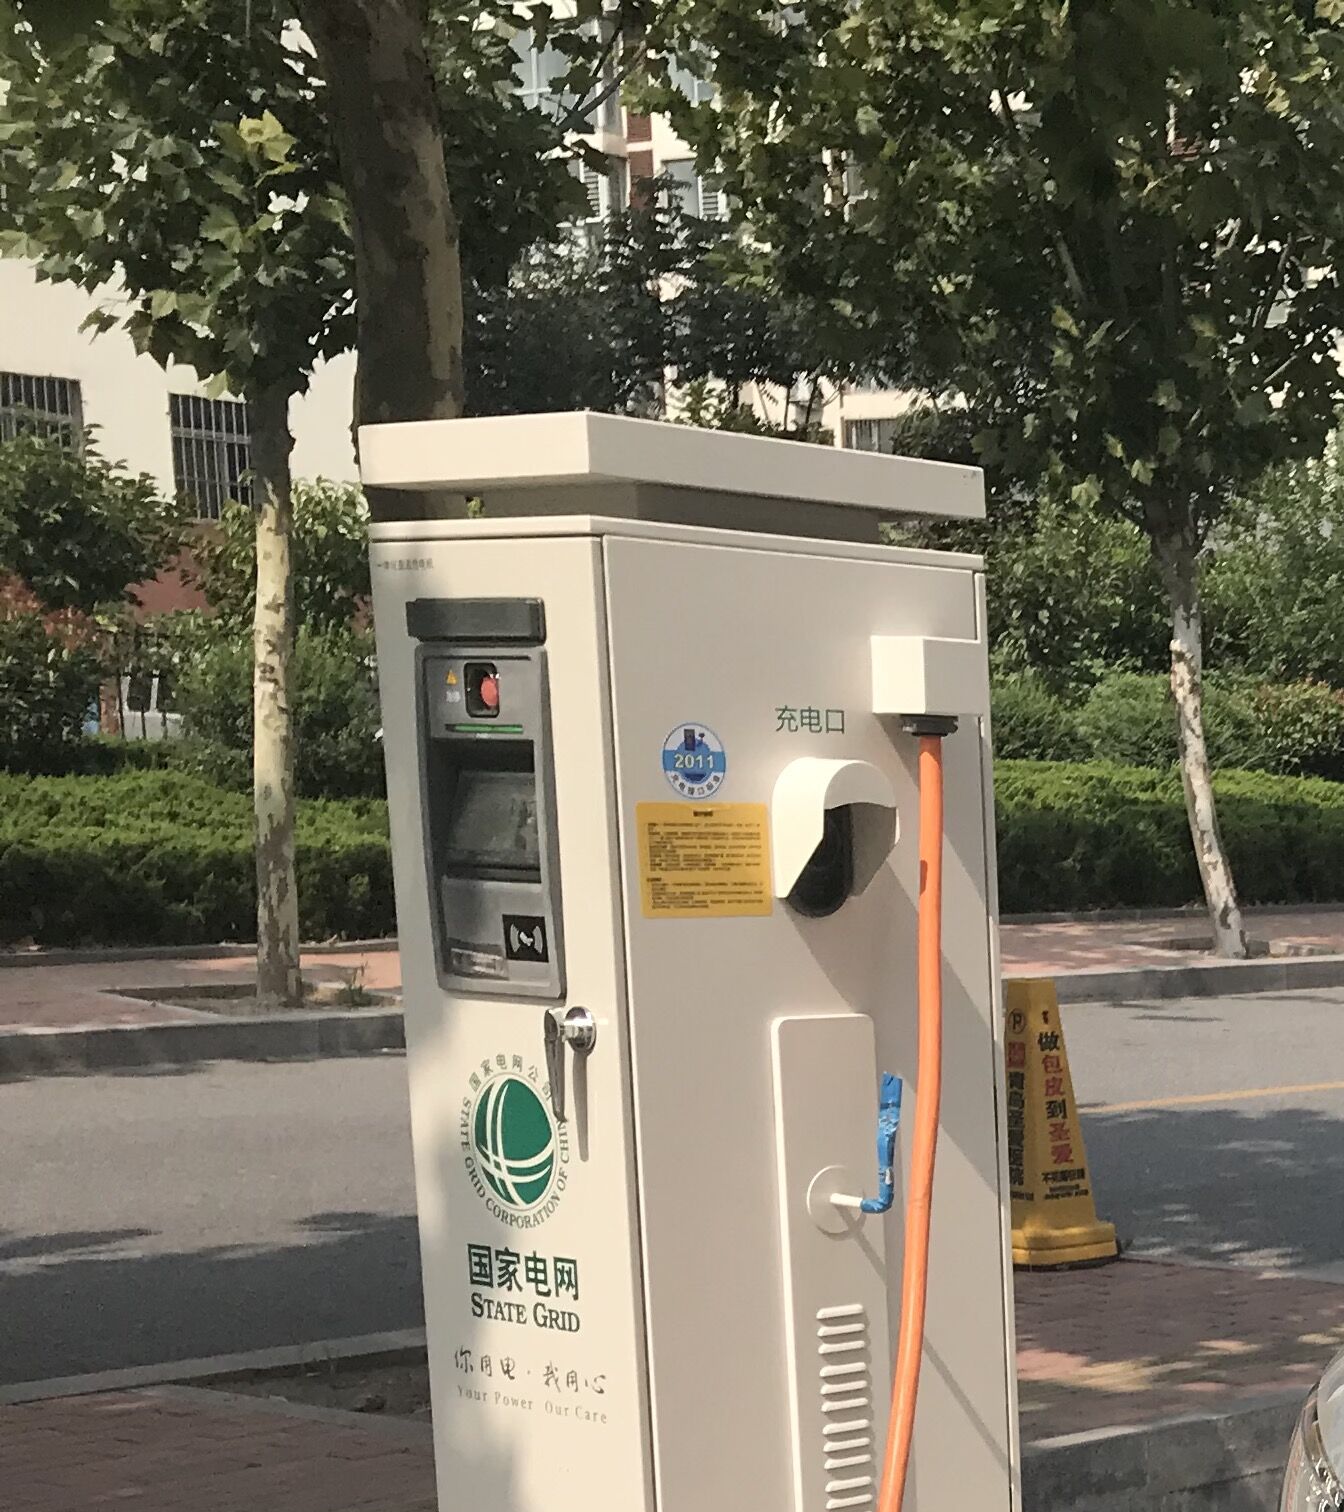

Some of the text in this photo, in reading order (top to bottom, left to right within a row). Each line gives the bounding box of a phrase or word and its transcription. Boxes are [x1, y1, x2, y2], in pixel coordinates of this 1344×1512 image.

[775, 705, 845, 734] 充电口
[674, 753, 714, 769] 2011
[460, 1097, 570, 1229] STATE GRID CORPORATION OF CHIN
[467, 1243, 579, 1301] 国家电网
[471, 1292, 581, 1333] STATE GRID
[457, 1385, 608, 1425] Your Power Our Care
